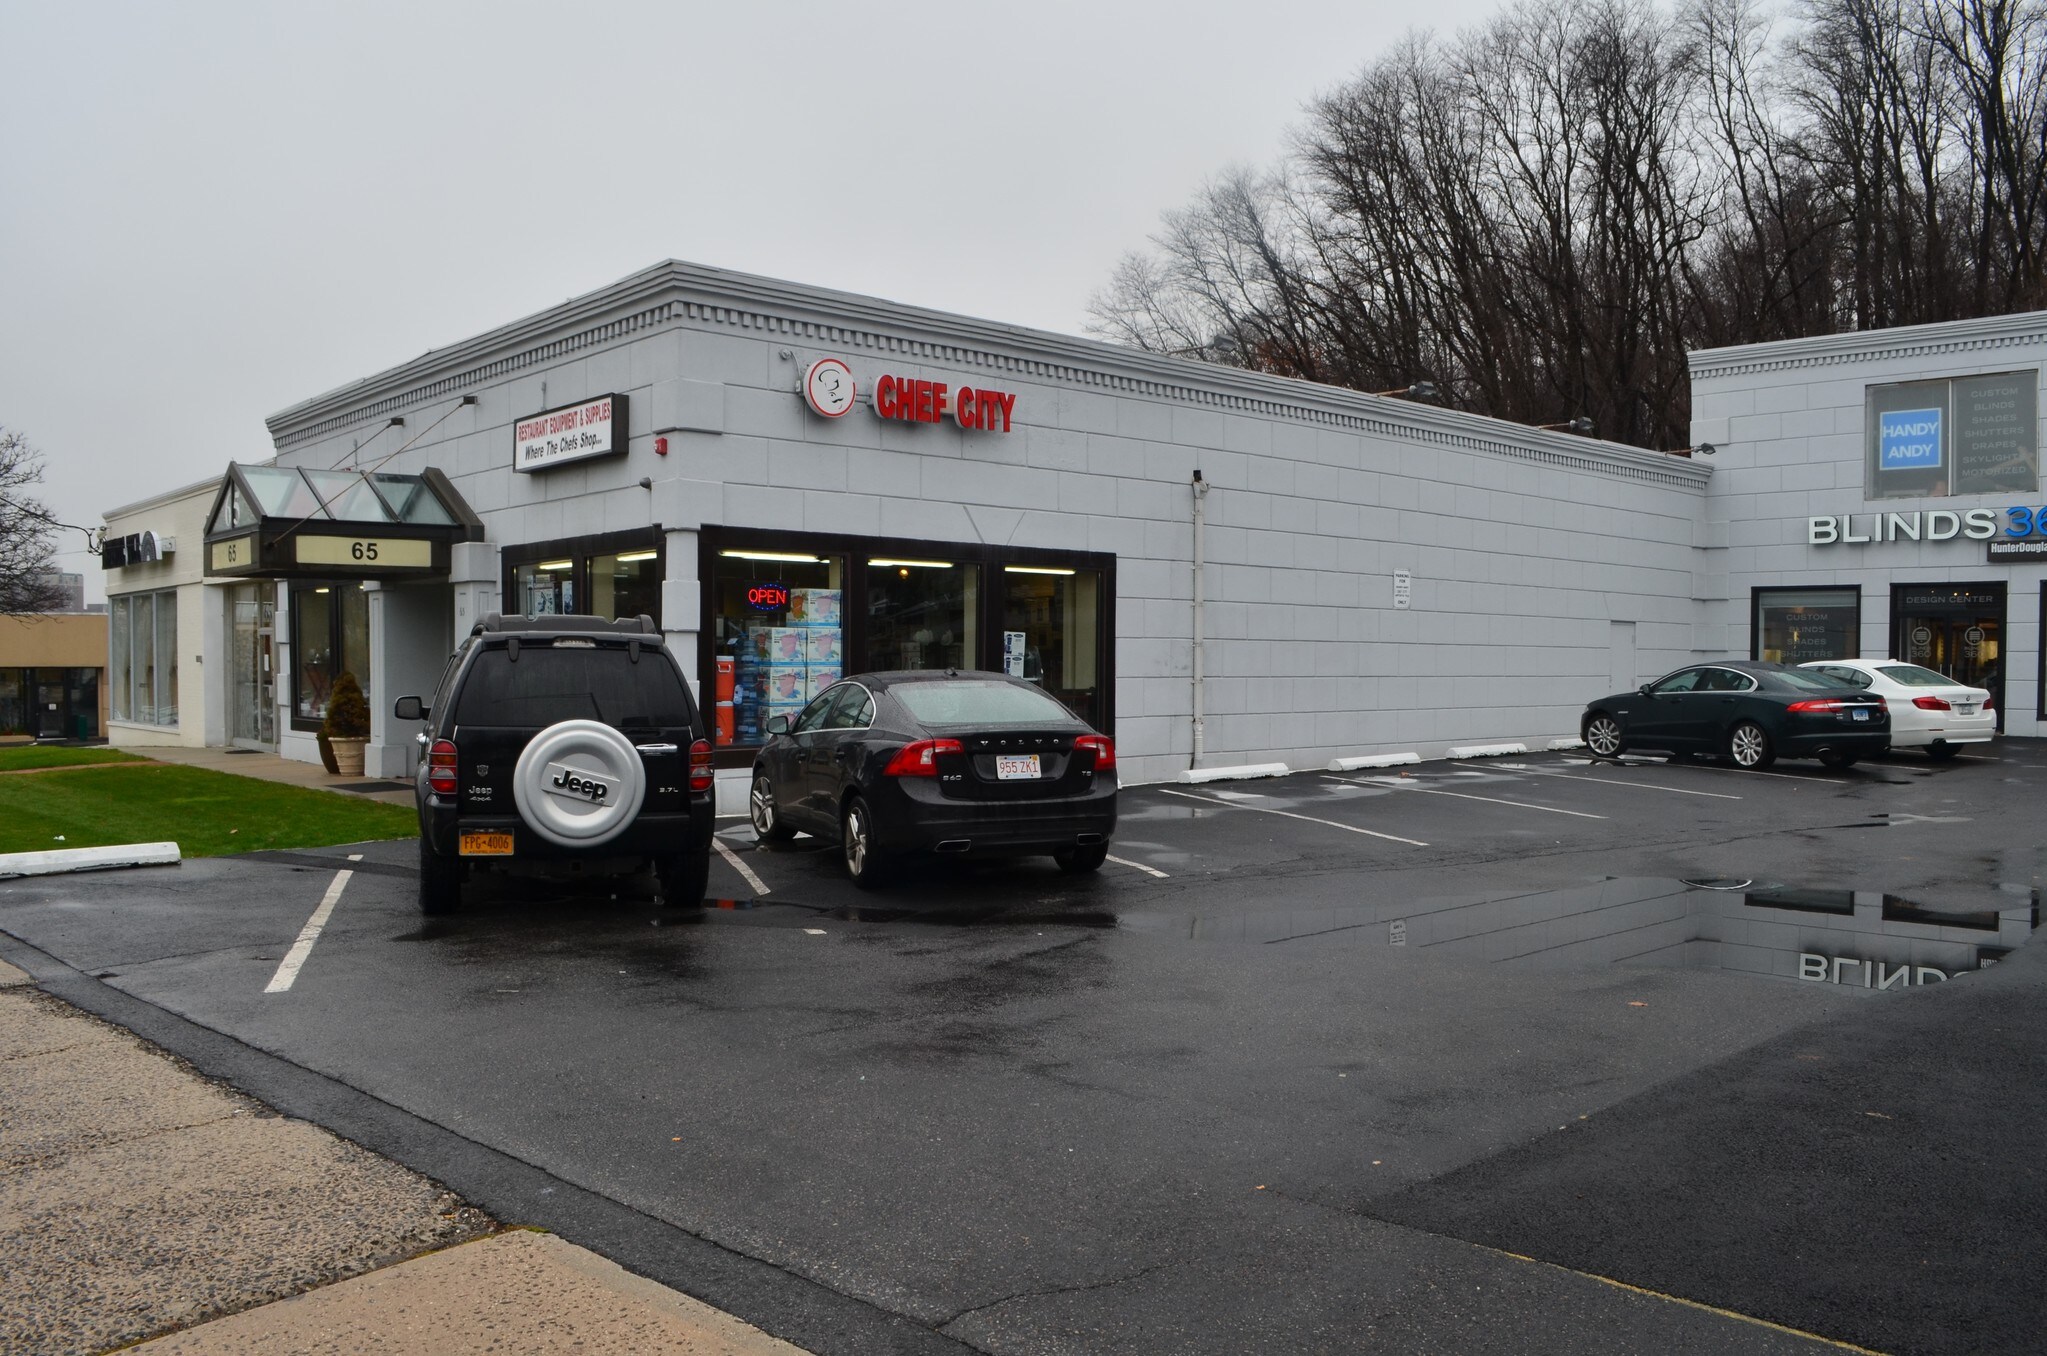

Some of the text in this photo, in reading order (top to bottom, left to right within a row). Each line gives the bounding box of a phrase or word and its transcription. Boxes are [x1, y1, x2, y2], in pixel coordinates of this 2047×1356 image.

[1971, 387, 2019, 398] CUSTOM
[875, 374, 1017, 433] CHEF CITY
[1974, 401, 2015, 411] BLINDS
[518, 401, 611, 442] RESTAURANT EQUIPMENT & SUPPLIES
[1971, 414, 2017, 424] SHADES
[1883, 422, 1938, 438] HANDY
[1965, 426, 2025, 438] SHUTTERS
[525, 446, 544, 461] Where
[546, 440, 558, 456] The
[560, 438, 578, 453] Chefs
[1888, 444, 1933, 459] ANDY
[1972, 440, 2017, 450] DRAPES
[1961, 466, 2026, 477] MOTORIZED
[1808, 508, 1998, 544] BLINDS
[228, 544, 237, 562] 65
[351, 541, 378, 561] 65
[748, 588, 787, 605] OPEN
[1906, 595, 1993, 604] DESIGN CENTER
[1781, 650, 1833, 658] SHUTTERS
[1000, 761, 1038, 774] 955 ZK1
[468, 785, 493, 795] Jeep
[552, 770, 608, 800] Jeep
